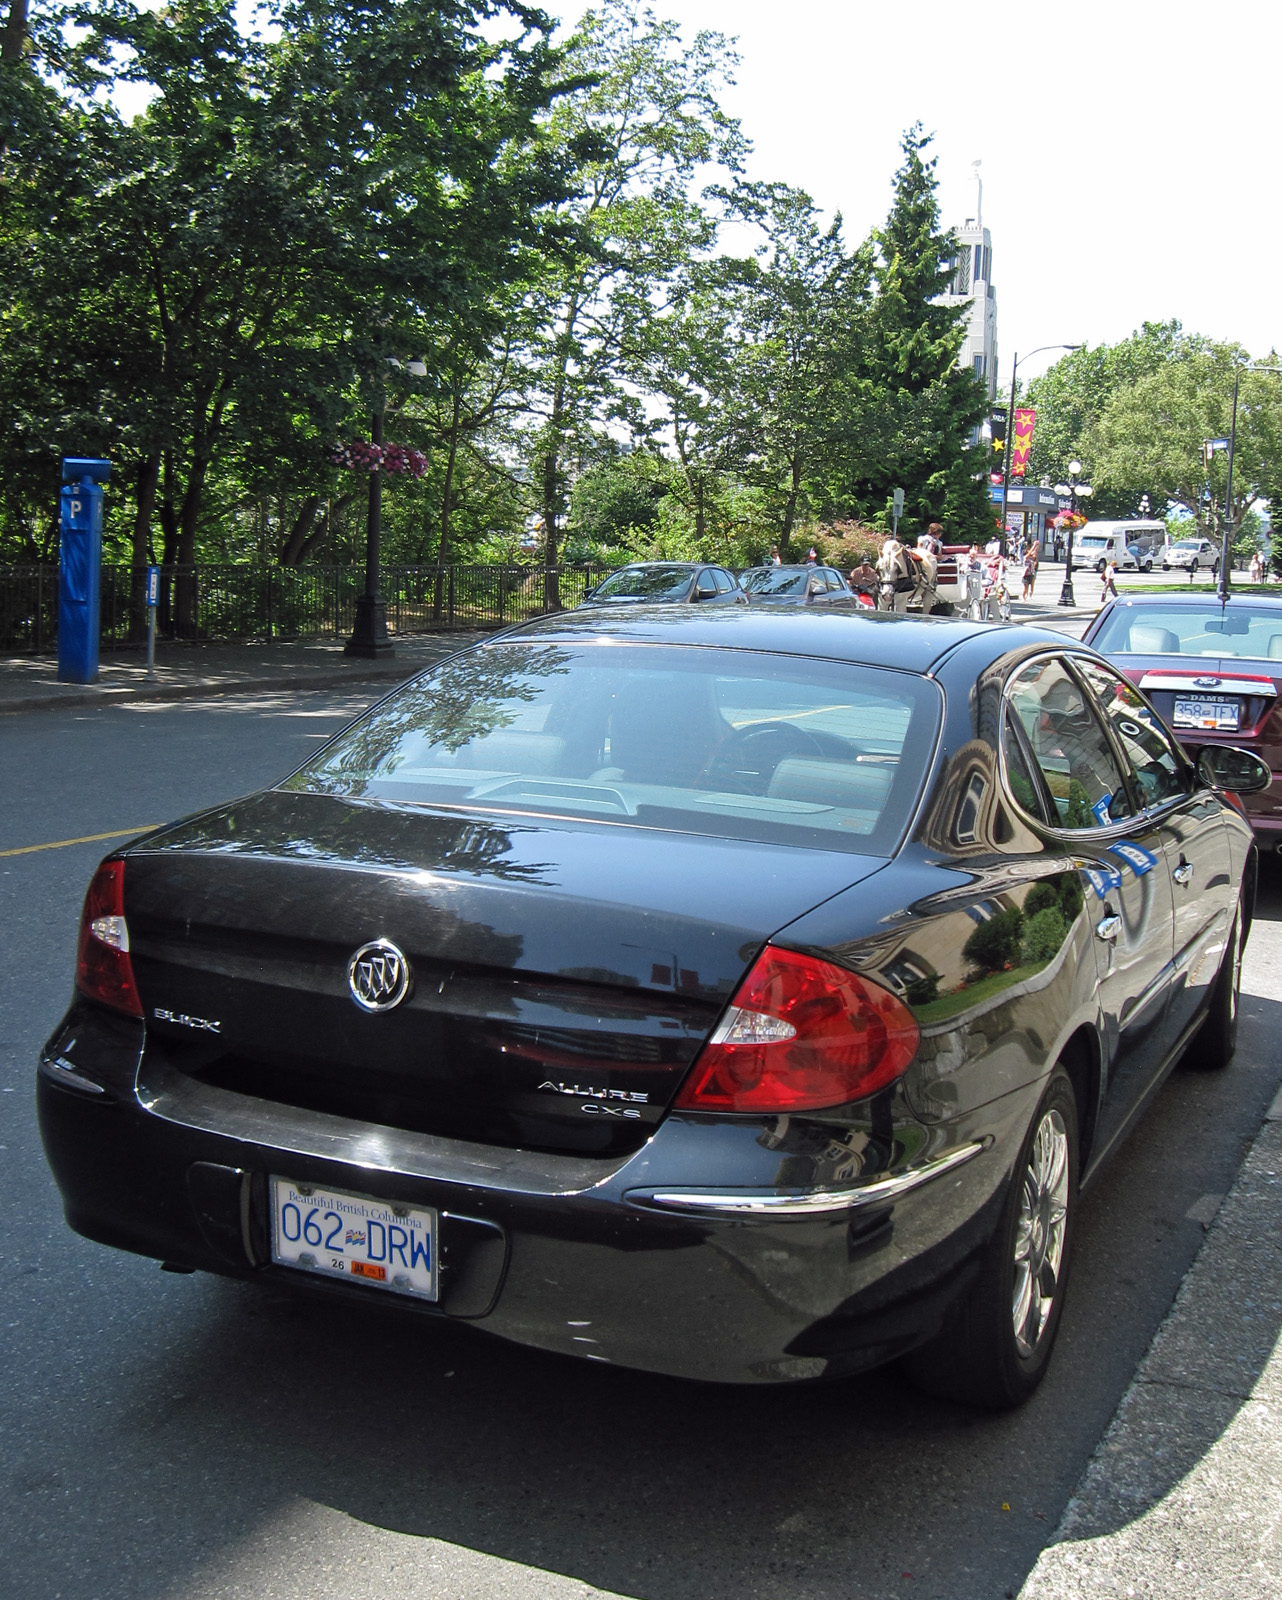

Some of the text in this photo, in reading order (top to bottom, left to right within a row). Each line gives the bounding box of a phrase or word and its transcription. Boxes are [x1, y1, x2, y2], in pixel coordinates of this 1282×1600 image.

[70, 500, 82, 519] P
[1190, 694, 1225, 703] DAMS
[1175, 702, 1202, 719] 358
[154, 1007, 221, 1034] BUICK
[537, 1080, 649, 1103] ALLURE
[580, 1103, 641, 1119] CXS
[288, 1190, 422, 1229] Beautiful British Columbia
[281, 1202, 431, 1273] 062 DRW
[331, 1257, 345, 1271] 26
